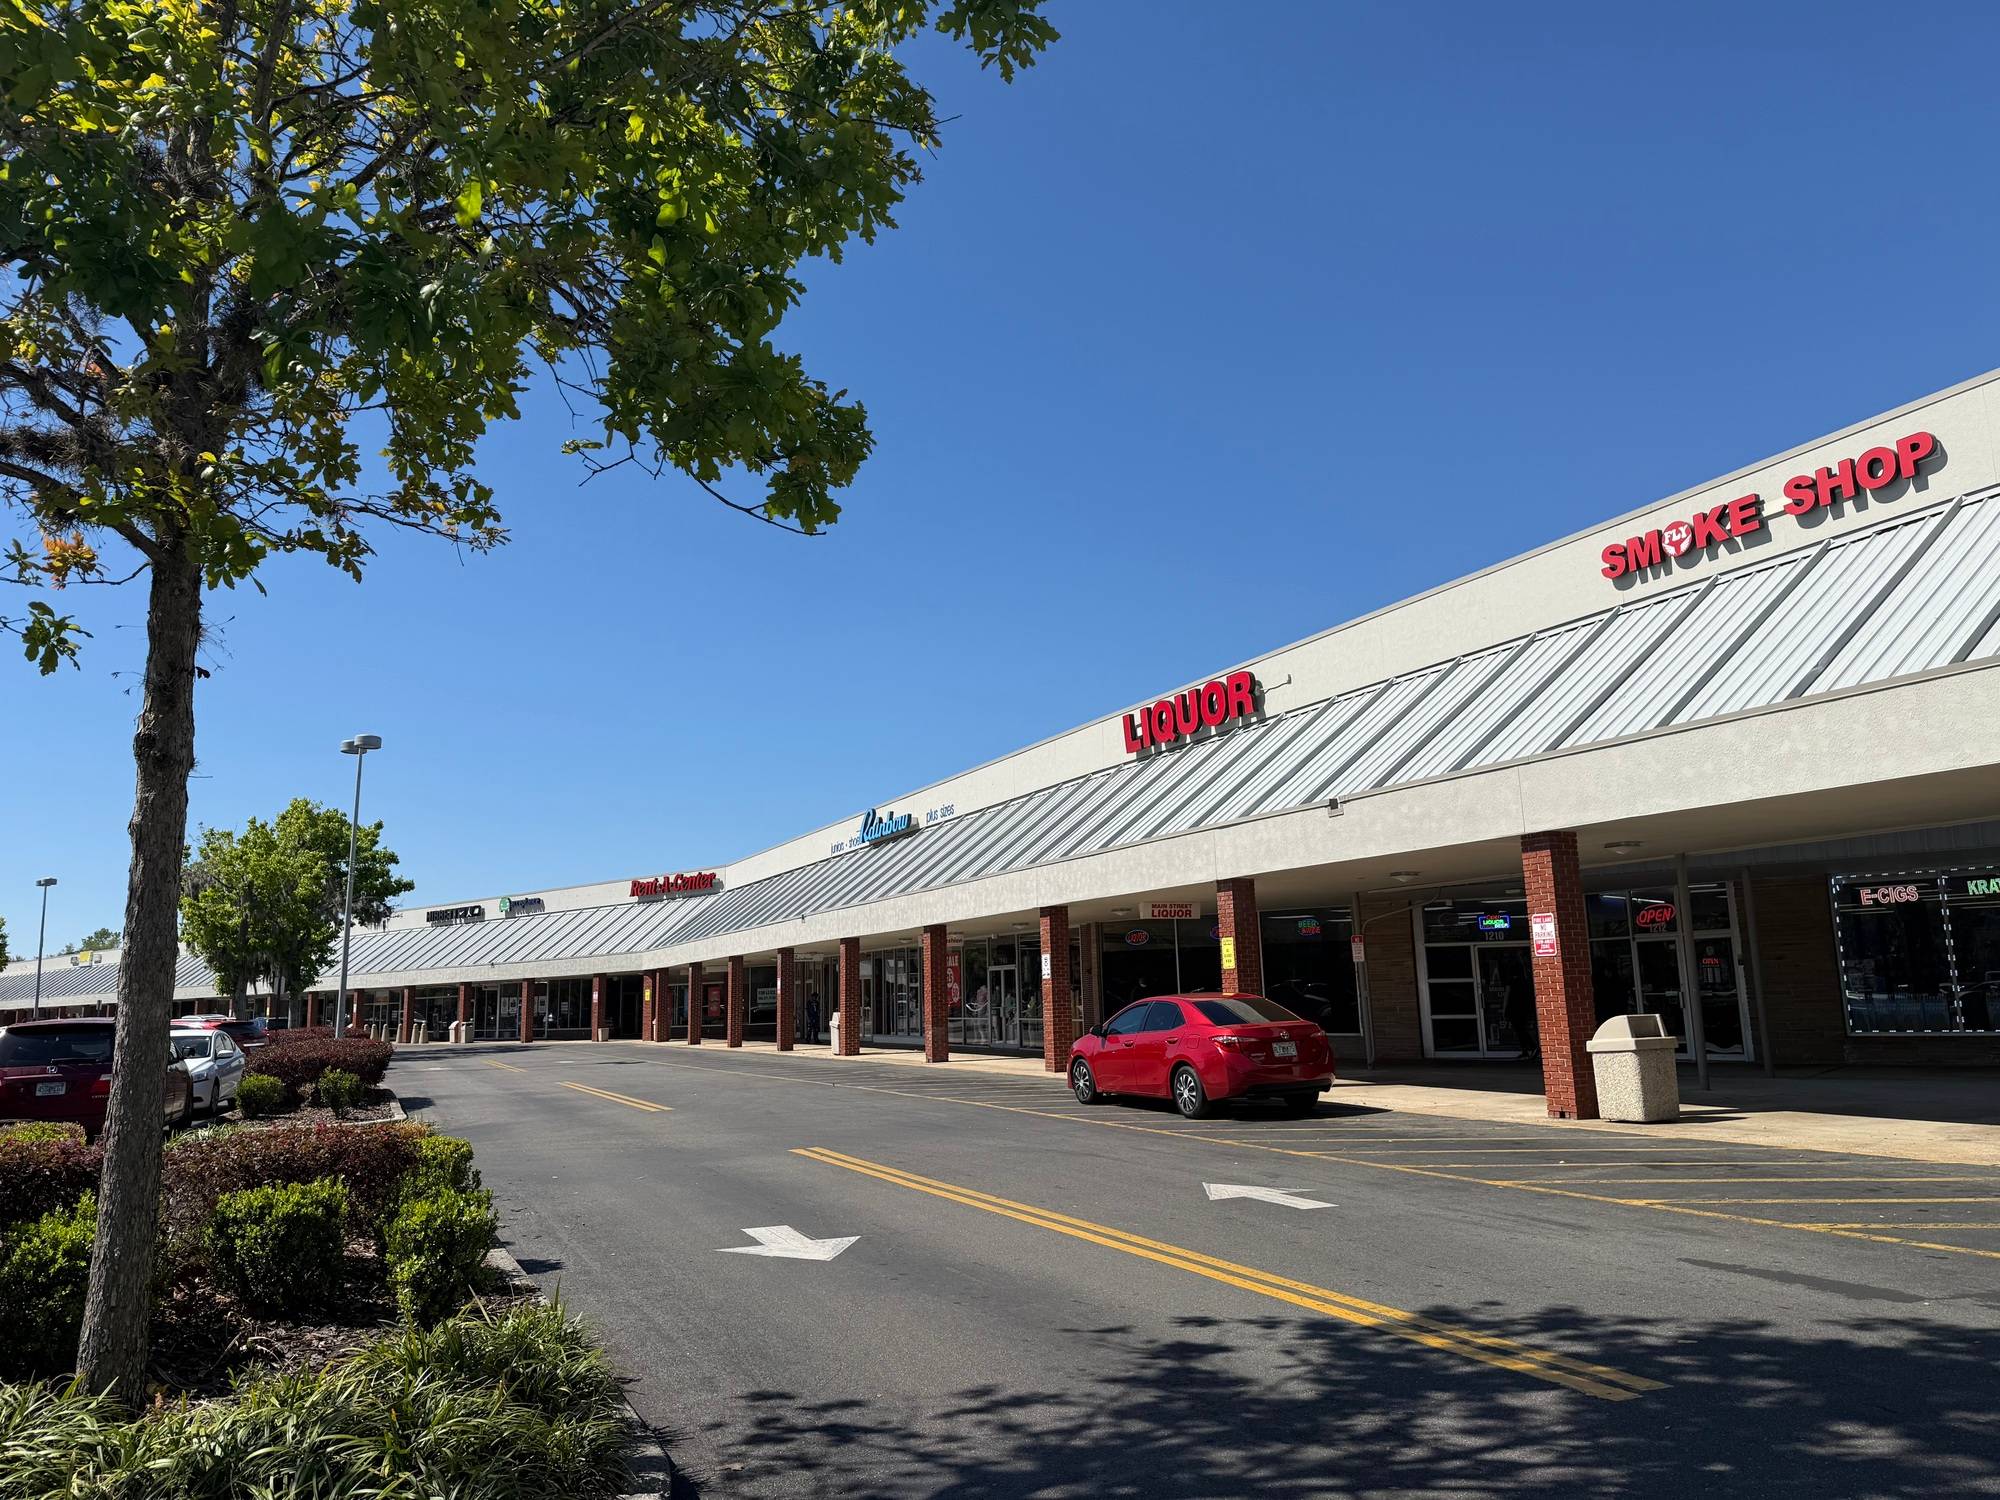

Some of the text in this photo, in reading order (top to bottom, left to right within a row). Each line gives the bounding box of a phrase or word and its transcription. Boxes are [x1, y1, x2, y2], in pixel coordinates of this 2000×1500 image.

[1783, 431, 1935, 515] SHOP
[1664, 523, 1688, 543] FLY
[1122, 671, 1257, 754] LIQUOR
[926, 803, 955, 825] plus sizes
[860, 808, 912, 843] Rainbow
[1860, 885, 1919, 905] E-CIGS
[1151, 909, 1192, 918] LIQUOR
[1640, 907, 1672, 923] OPEN
[1484, 931, 1505, 941] 1210
